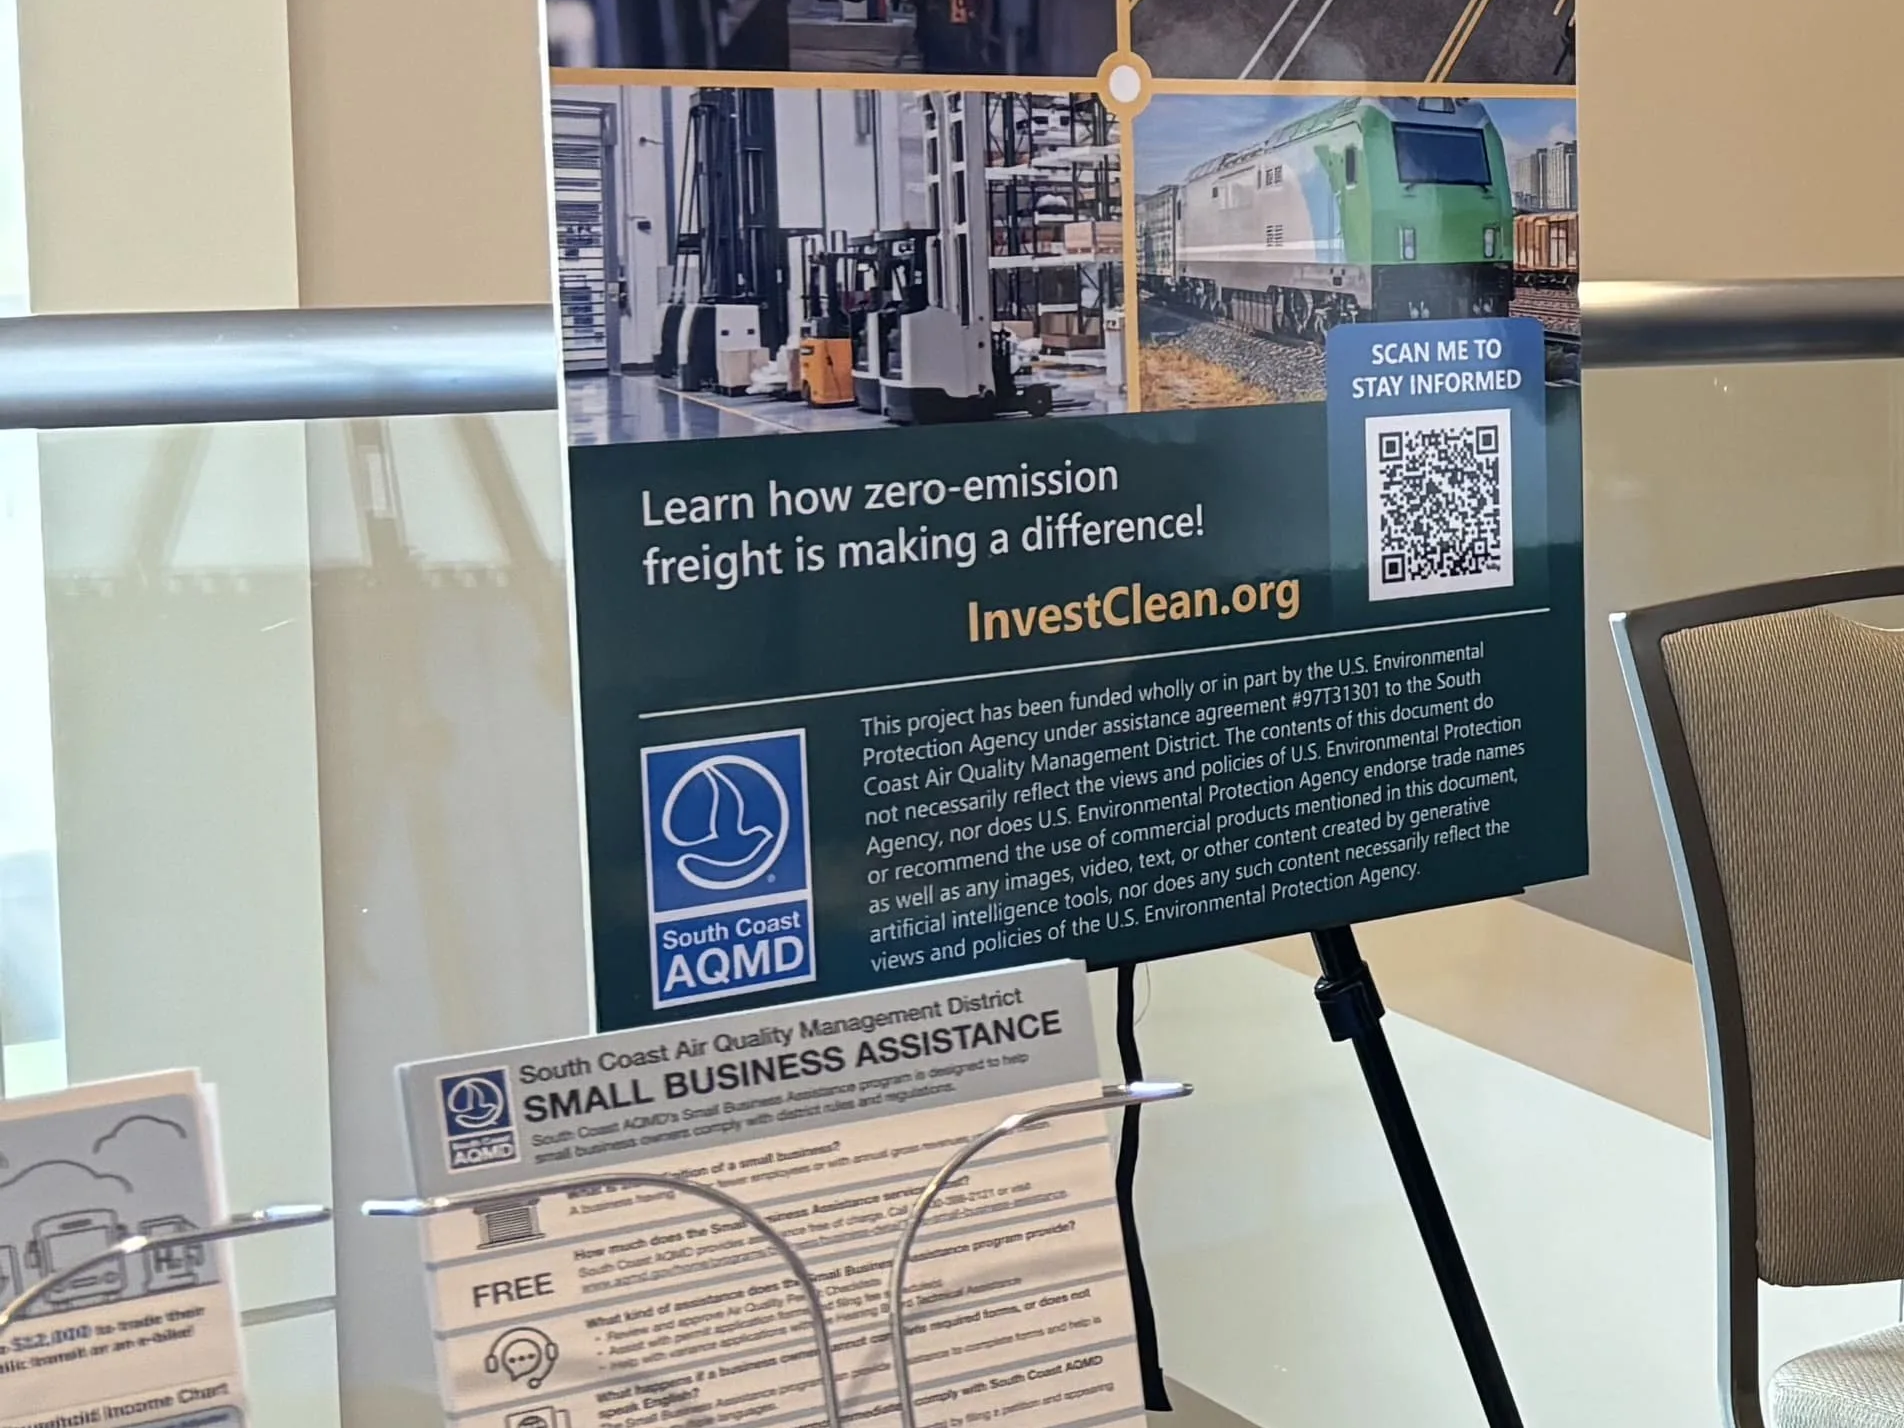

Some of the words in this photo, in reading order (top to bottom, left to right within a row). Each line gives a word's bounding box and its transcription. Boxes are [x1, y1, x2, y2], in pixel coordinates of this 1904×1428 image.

[1351, 374, 1404, 399] STAY
[1409, 368, 1522, 396] INFORMED
[1371, 340, 1430, 365] SCAN
[1436, 339, 1469, 362] ME
[1472, 337, 1502, 360] TO
[641, 489, 754, 527] Learn
[768, 479, 853, 517] how
[863, 458, 1118, 510] zero-emission
[641, 539, 784, 591] freight
[795, 535, 825, 573] is
[838, 524, 977, 569] making
[989, 528, 1009, 555] a
[1021, 502, 1204, 552] difference!
[968, 578, 1300, 643] InvestClean.org
[859, 714, 902, 737] This
[906, 707, 975, 737] project
[980, 702, 1013, 723] has
[1017, 697, 1064, 717] been
[1068, 683, 1133, 711] funded
[1137, 677, 1195, 702] wholly
[1199, 678, 1219, 694] or
[1222, 672, 1238, 691] in
[1243, 669, 1278, 694] part
[1281, 664, 1303, 688] by
[1306, 660, 1334, 681] the
[1337, 655, 1369, 677] U.S.
[1373, 640, 1484, 672] Environmental
[862, 739, 963, 767] Protection
[968, 730, 1039, 756] Agency
[1043, 719, 1098, 743] under
[1102, 709, 1191, 735] assistance
[1195, 694, 1287, 726] agreement
[1291, 680, 1379, 708] #97T31301
[1384, 681, 1402, 697] to
[1405, 675, 1432, 694] the
[1436, 668, 1481, 690] South
[662, 922, 729, 950] South
[735, 910, 801, 937] Coast
[662, 936, 805, 994] AQMD
[518, 1056, 592, 1085] South
[597, 1044, 671, 1072] Coast
[674, 1038, 709, 1060] Air
[712, 1026, 794, 1053] Quality
[798, 1000, 943, 1039] Management
[946, 987, 1024, 1016] District
[522, 1078, 655, 1123] SMALL
[663, 1045, 846, 1100] BUSINESS
[854, 1008, 1063, 1068] ASSISTANCE
[450, 1141, 515, 1165] AQMD
[472, 1272, 556, 1309] FREE
